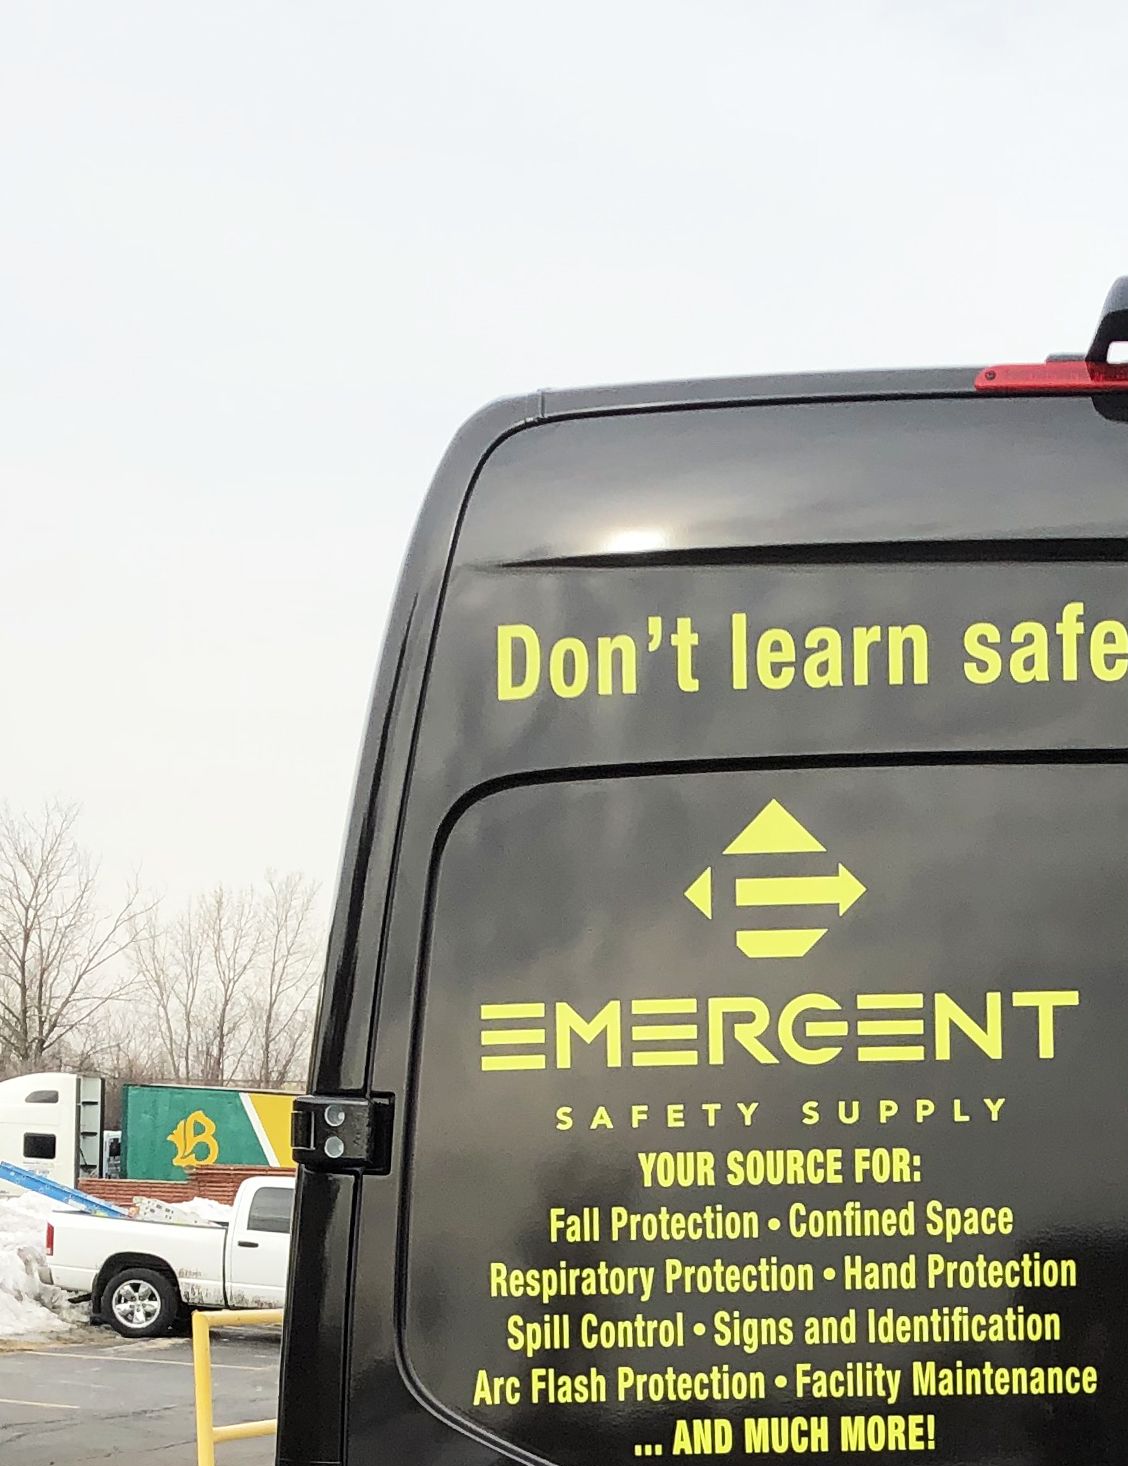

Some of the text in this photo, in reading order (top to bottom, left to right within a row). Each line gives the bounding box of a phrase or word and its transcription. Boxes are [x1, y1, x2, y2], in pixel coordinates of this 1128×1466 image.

[497, 616, 700, 701] Don't
[732, 612, 928, 689] learn
[480, 991, 1079, 1072] EMERGENT
[556, 1098, 1004, 1130] SAFETY SUPPLY
[639, 1148, 921, 1188] YOUR SOURCE FOR:
[550, 1200, 1013, 1243] Fall Protection Confined Space
[490, 1252, 1076, 1303] Respiratory Protection Hand Protection
[508, 1306, 1060, 1357] Spill Control Signs and Identification
[473, 1361, 1097, 1405] Arc Flash Protection Facility Maintenance
[673, 1419, 732, 1455] AND
[744, 1416, 828, 1453] MUCH
[841, 1415, 935, 1451] MORE!
